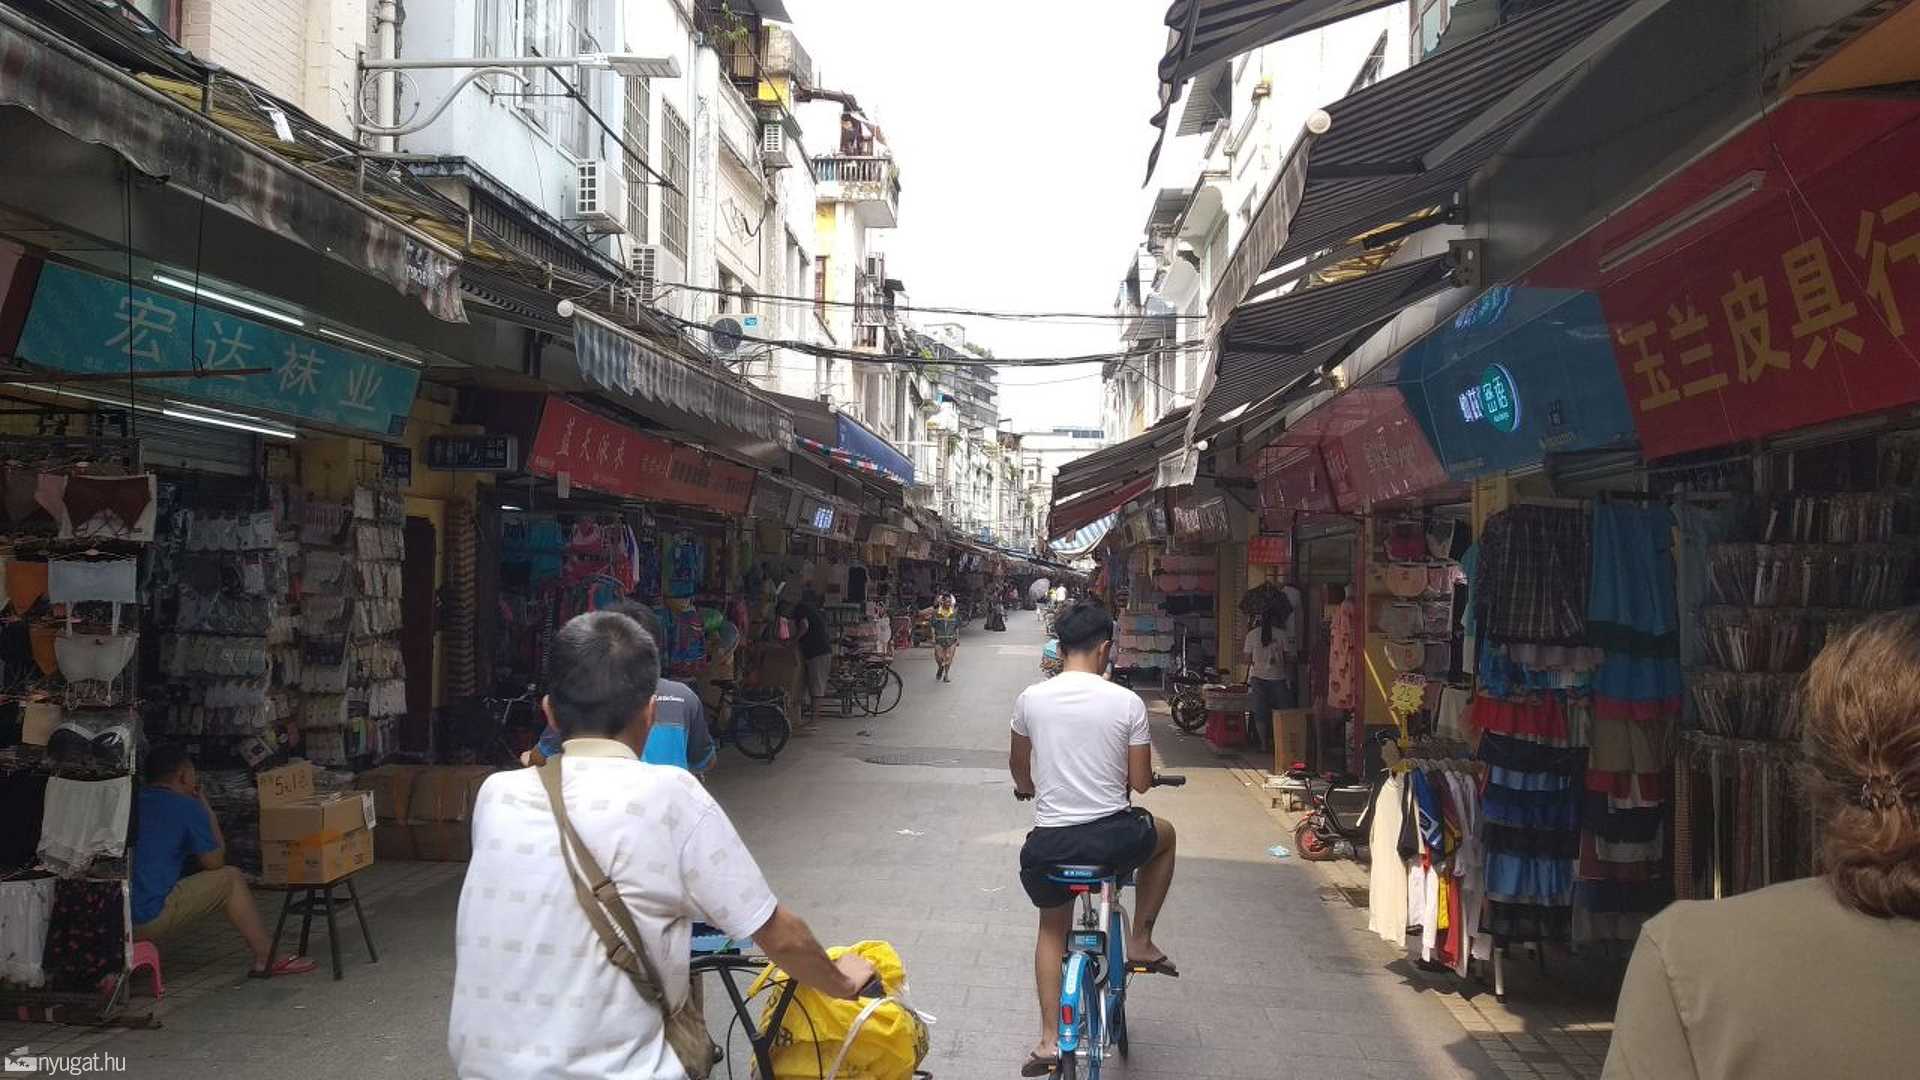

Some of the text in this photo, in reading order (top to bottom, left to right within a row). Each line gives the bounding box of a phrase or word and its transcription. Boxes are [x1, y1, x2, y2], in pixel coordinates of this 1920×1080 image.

[105, 295, 384, 412] 宏达袜业
[1618, 190, 1920, 413] 玉兰皮具行
